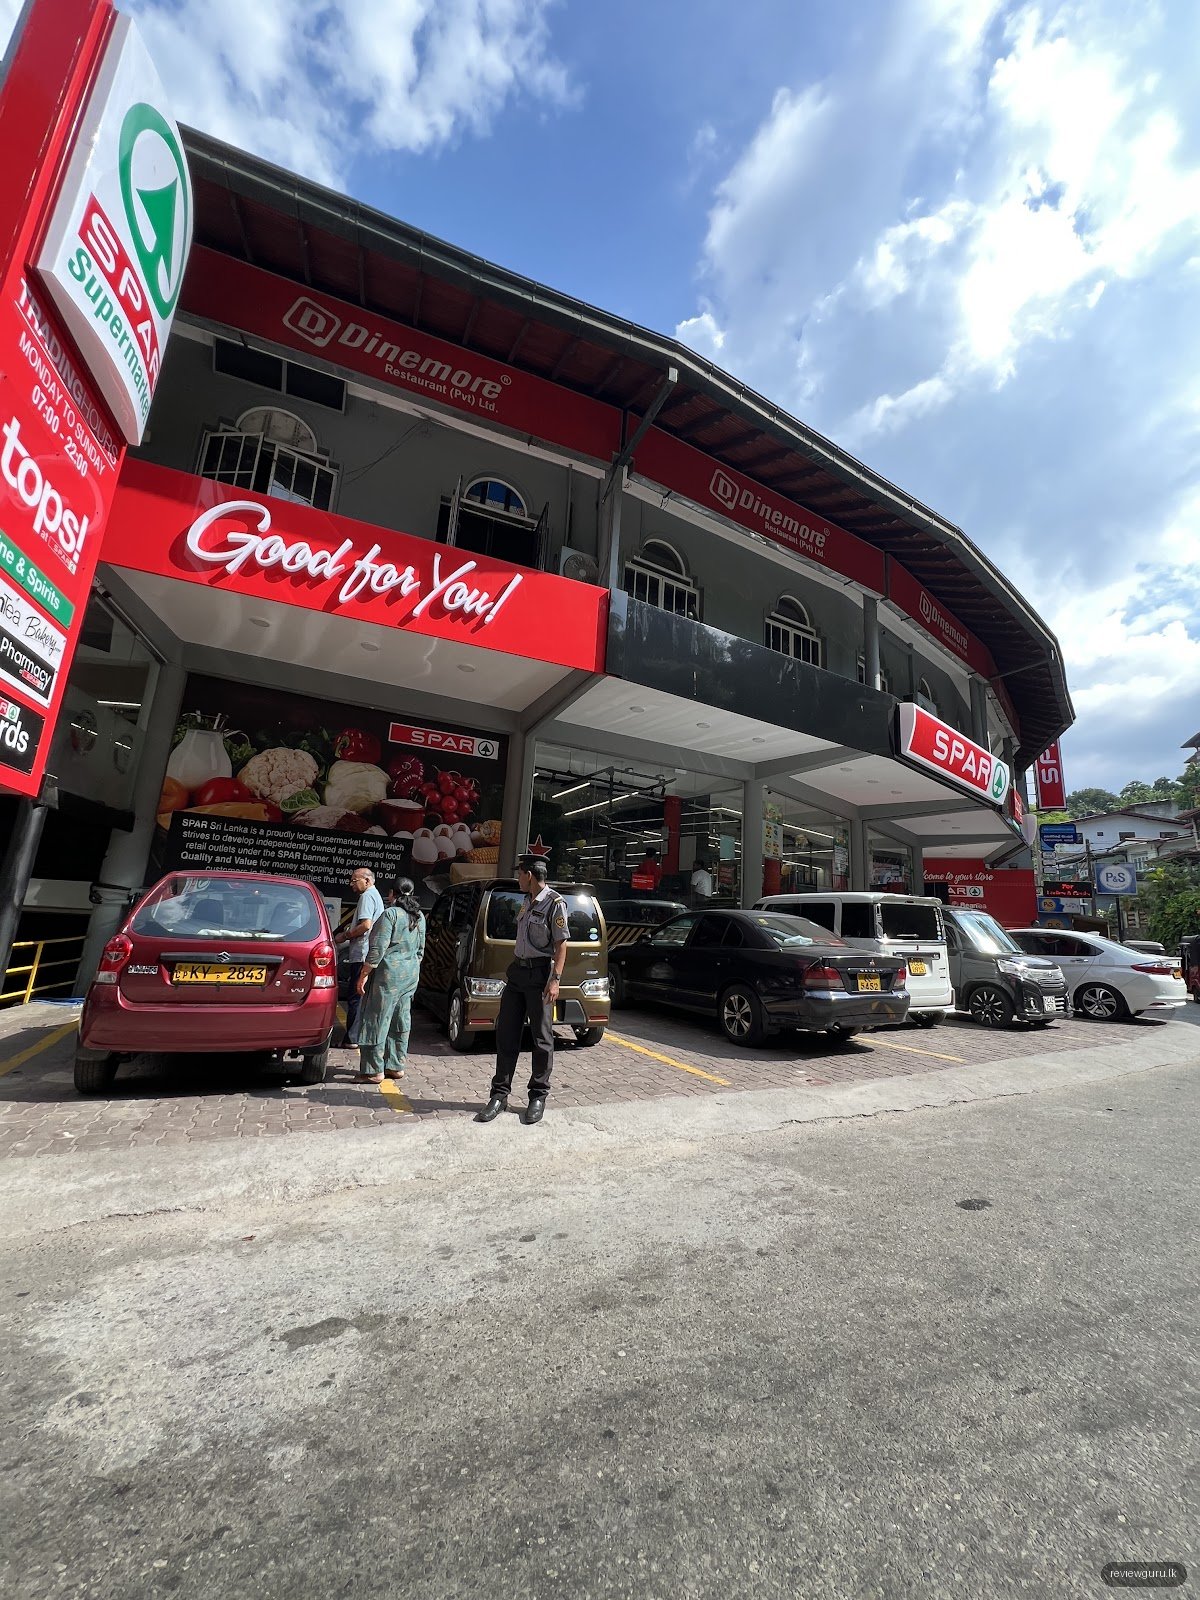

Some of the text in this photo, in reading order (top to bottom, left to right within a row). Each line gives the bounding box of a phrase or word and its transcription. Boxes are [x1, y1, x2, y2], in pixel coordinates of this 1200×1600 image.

[19, 331, 106, 476] MONDAY TO SUNDAY
[384, 363, 499, 414] Restaurant (Pvt) Ltd.
[31, 384, 60, 434] 07:00
[63, 434, 89, 478] 22:00
[1, 416, 89, 564] tops!
[40, 530, 49, 546] at
[764, 521, 799, 547] Restaurant
[0, 535, 60, 612] ne & Spirits
[186, 500, 524, 625] Good for You!
[23, 615, 57, 656] Bakery
[1, 636, 52, 686] Pharmacy
[0, 720, 30, 753] rds
[410, 730, 474, 752] SPAR
[932, 729, 992, 786] SPAR
[182, 819, 405, 852] SPAR Sri Lanka is a proudly local supermarket family which
[182, 830, 402, 861] strives to develop independently owned and operated food
[180, 851, 213, 864] Quality
[215, 856, 232, 864] and
[234, 856, 258, 866] Value
[259, 859, 270, 867] for
[272, 861, 298, 872] money
[299, 863, 334, 876] shopping
[376, 871, 384, 879] to
[384, 872, 397, 880] our
[185, 842, 207, 850] retail
[208, 844, 236, 854] outlets
[238, 848, 261, 856] under
[263, 849, 276, 858] the
[277, 850, 302, 860] SPAR
[302, 853, 331, 864] banner.
[332, 856, 345, 865] We
[346, 859, 372, 868] provide
[380, 862, 396, 871] high
[323, 875, 338, 884] that
[945, 871, 954, 880] to
[953, 873, 973, 885] your
[973, 871, 995, 881] store
[1105, 872, 1126, 883] P&S
[190, 965, 212, 979] KY
[226, 966, 265, 981] 2843
